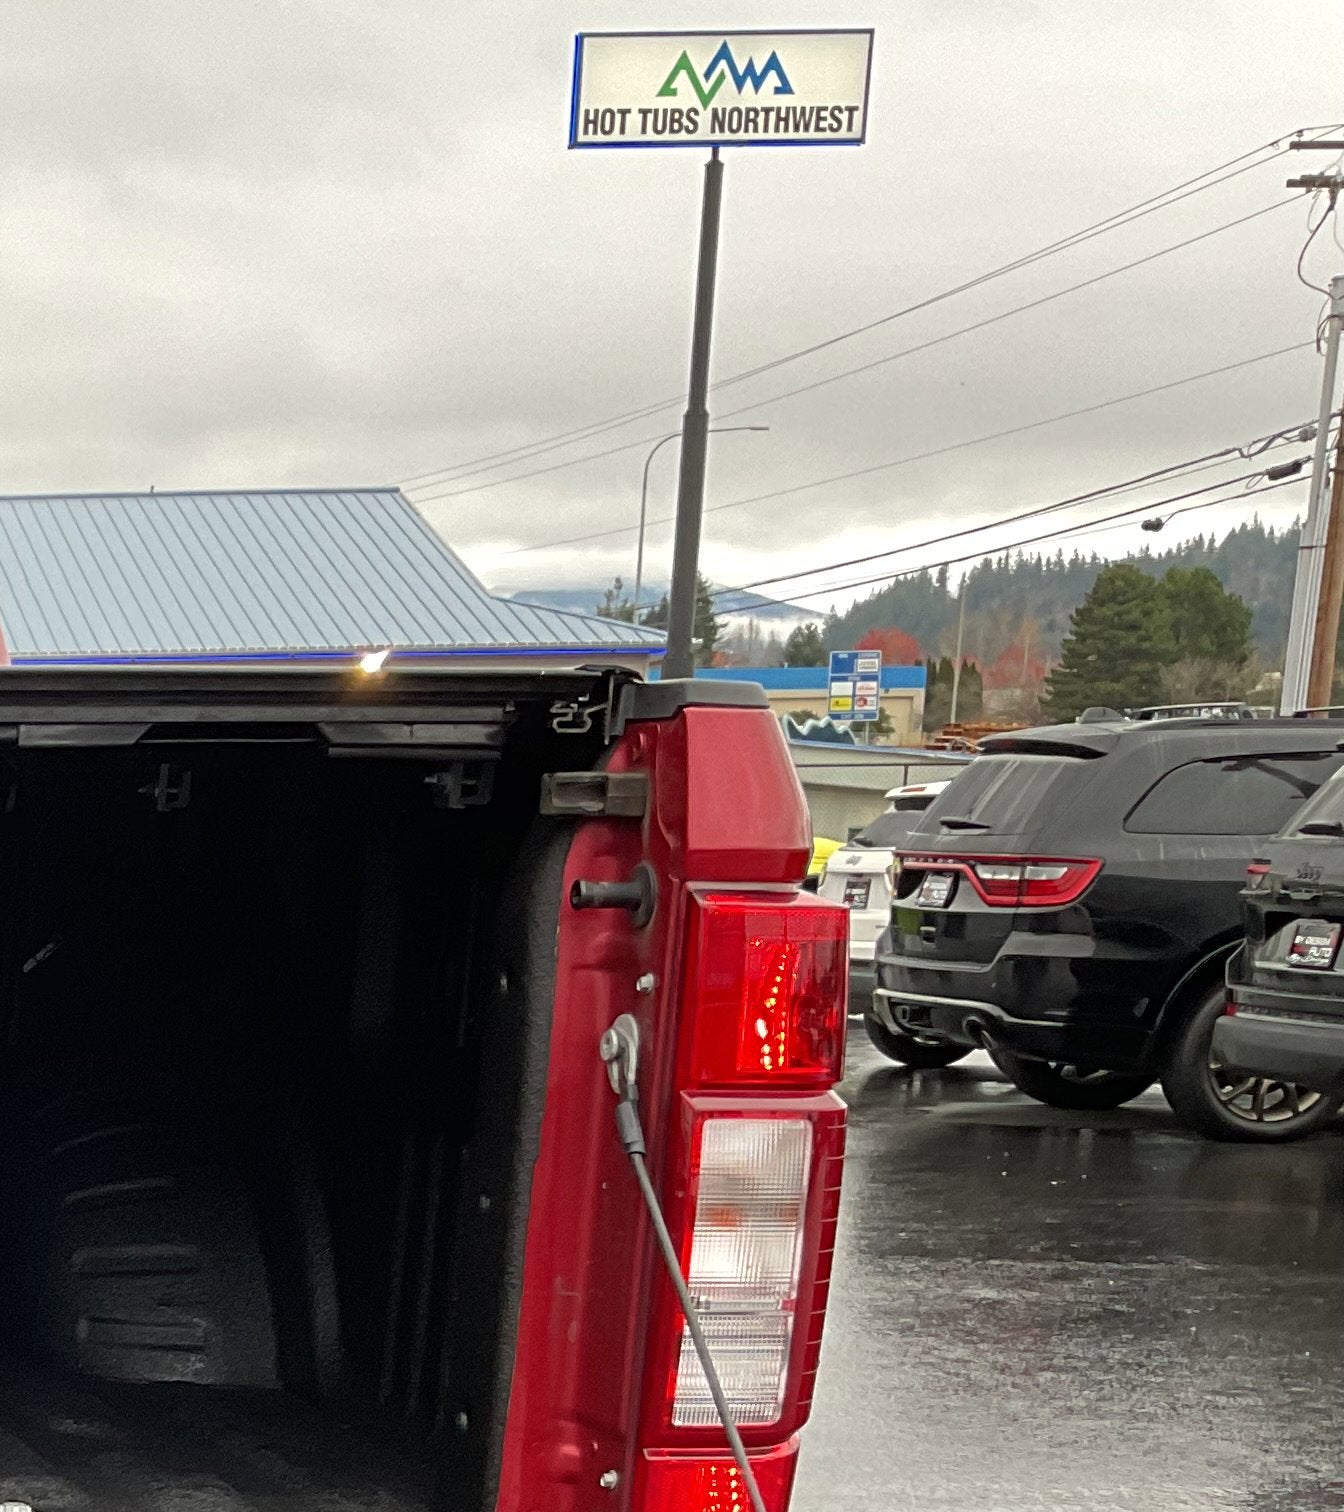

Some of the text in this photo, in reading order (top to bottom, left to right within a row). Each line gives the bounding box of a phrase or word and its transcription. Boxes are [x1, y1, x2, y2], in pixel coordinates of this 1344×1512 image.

[582, 105, 859, 136] HOT TUBS NORTHWEST
